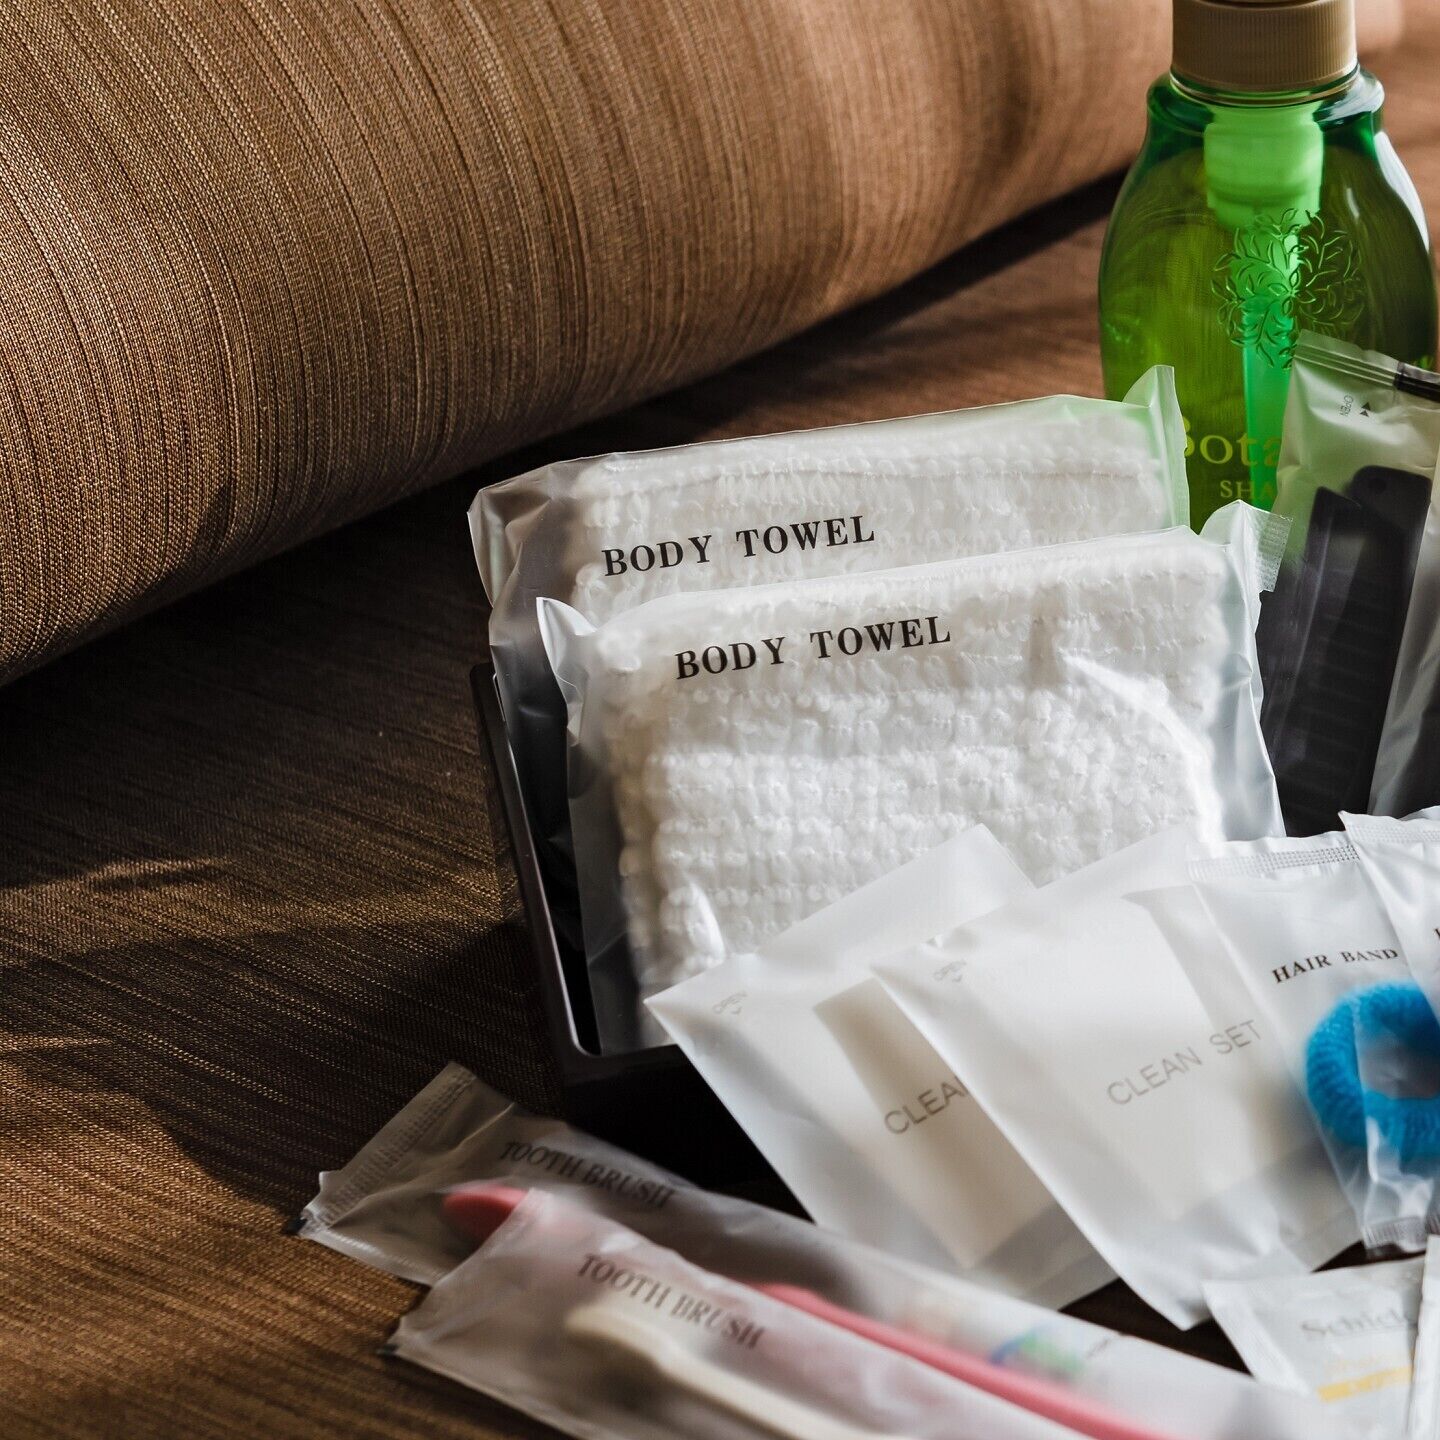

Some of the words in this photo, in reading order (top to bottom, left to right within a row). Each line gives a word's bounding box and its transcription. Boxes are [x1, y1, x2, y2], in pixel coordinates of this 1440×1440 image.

[601, 533, 713, 577] BODY
[736, 514, 875, 559] TOWEL
[674, 636, 786, 680] BODY
[809, 616, 952, 659] TOWEL
[1271, 953, 1333, 984] HAIR
[1340, 948, 1399, 964] BAND
[1106, 1046, 1203, 1107] CLEAN
[1209, 1018, 1264, 1057] SET
[499, 1140, 584, 1178] TOOTH
[583, 1163, 678, 1208] BRUSH
[577, 1252, 672, 1309] TOOTH
[670, 1292, 766, 1349] BRUSH
